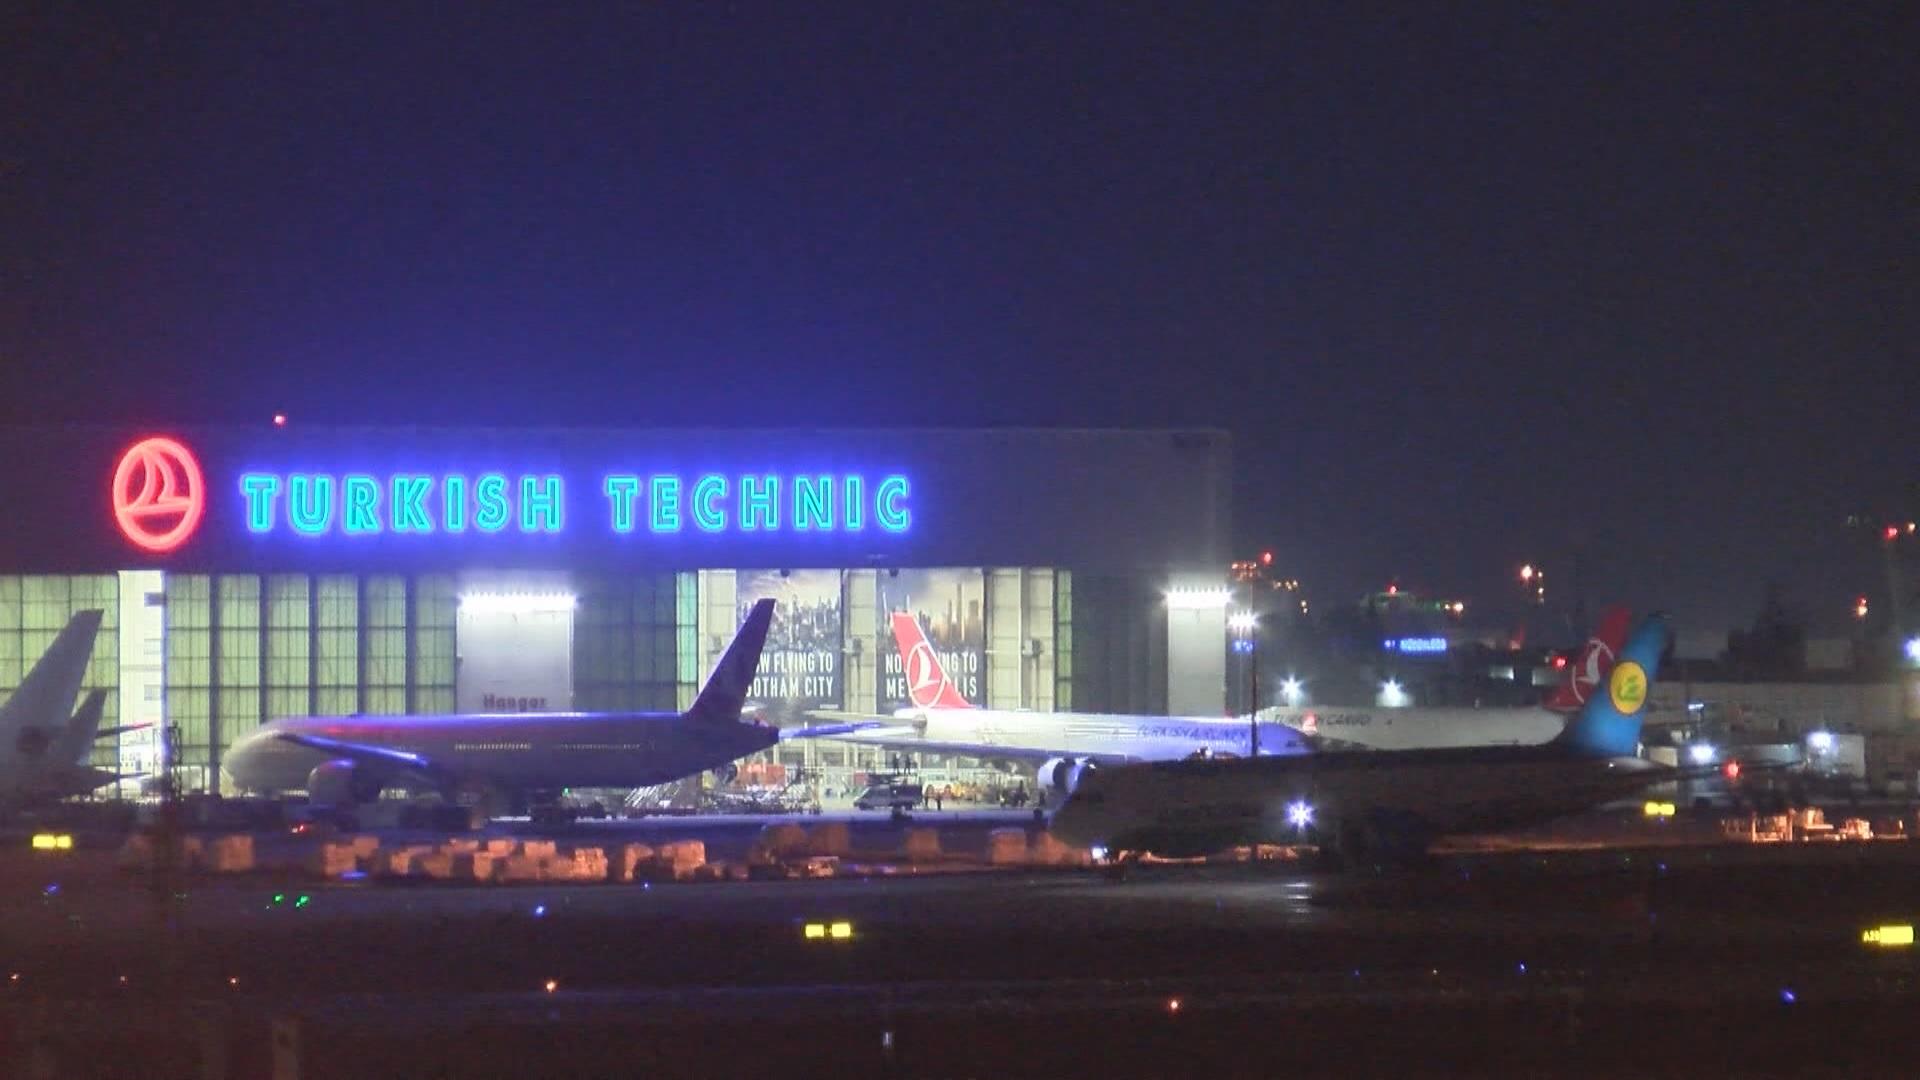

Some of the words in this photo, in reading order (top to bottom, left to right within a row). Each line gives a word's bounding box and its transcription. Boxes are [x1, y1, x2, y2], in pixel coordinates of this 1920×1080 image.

[242, 473, 562, 533] TURKISH
[605, 474, 910, 532] TECHNIC
[774, 651, 815, 674] FLYING
[819, 652, 833, 674] TO
[961, 651, 977, 674] TO
[804, 676, 833, 698] CITY
